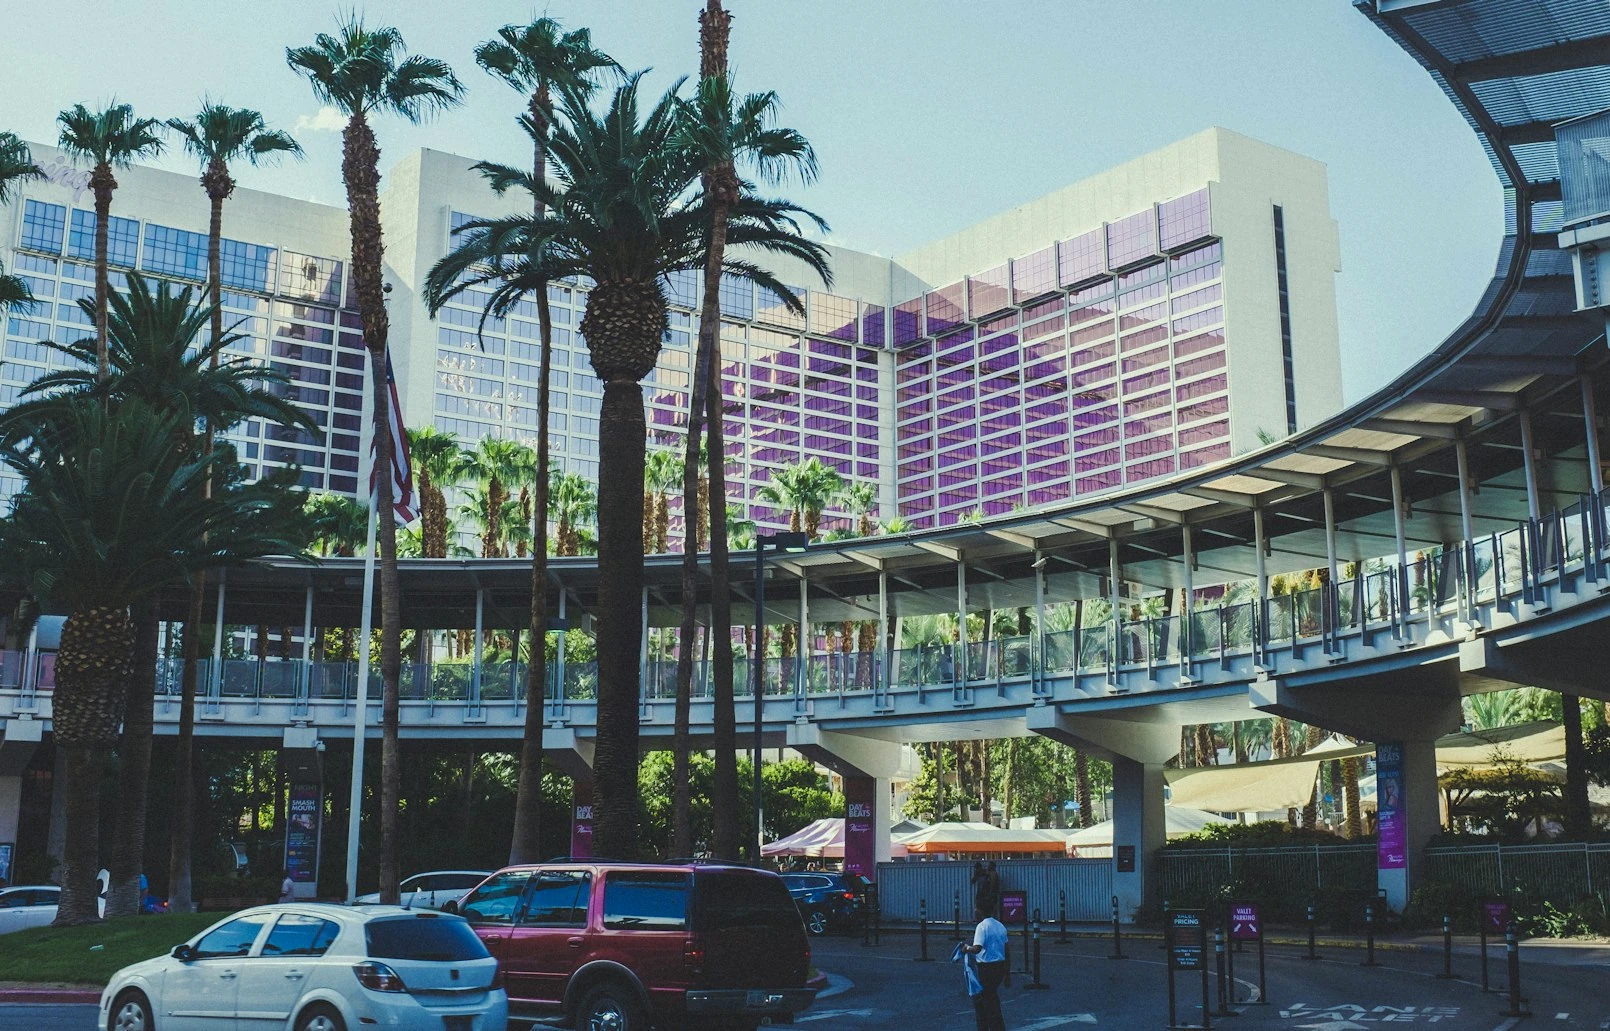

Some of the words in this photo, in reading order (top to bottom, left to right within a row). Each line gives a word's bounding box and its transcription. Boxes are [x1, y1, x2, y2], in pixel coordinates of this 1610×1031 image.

[1378, 745, 1393, 753] DAY
[1378, 752, 1400, 762] BEATS
[848, 803, 864, 811] DAY
[848, 810, 871, 818] BEATS
[1288, 1003, 1461, 1013] LANE
[1279, 1010, 1456, 1023] VALET
